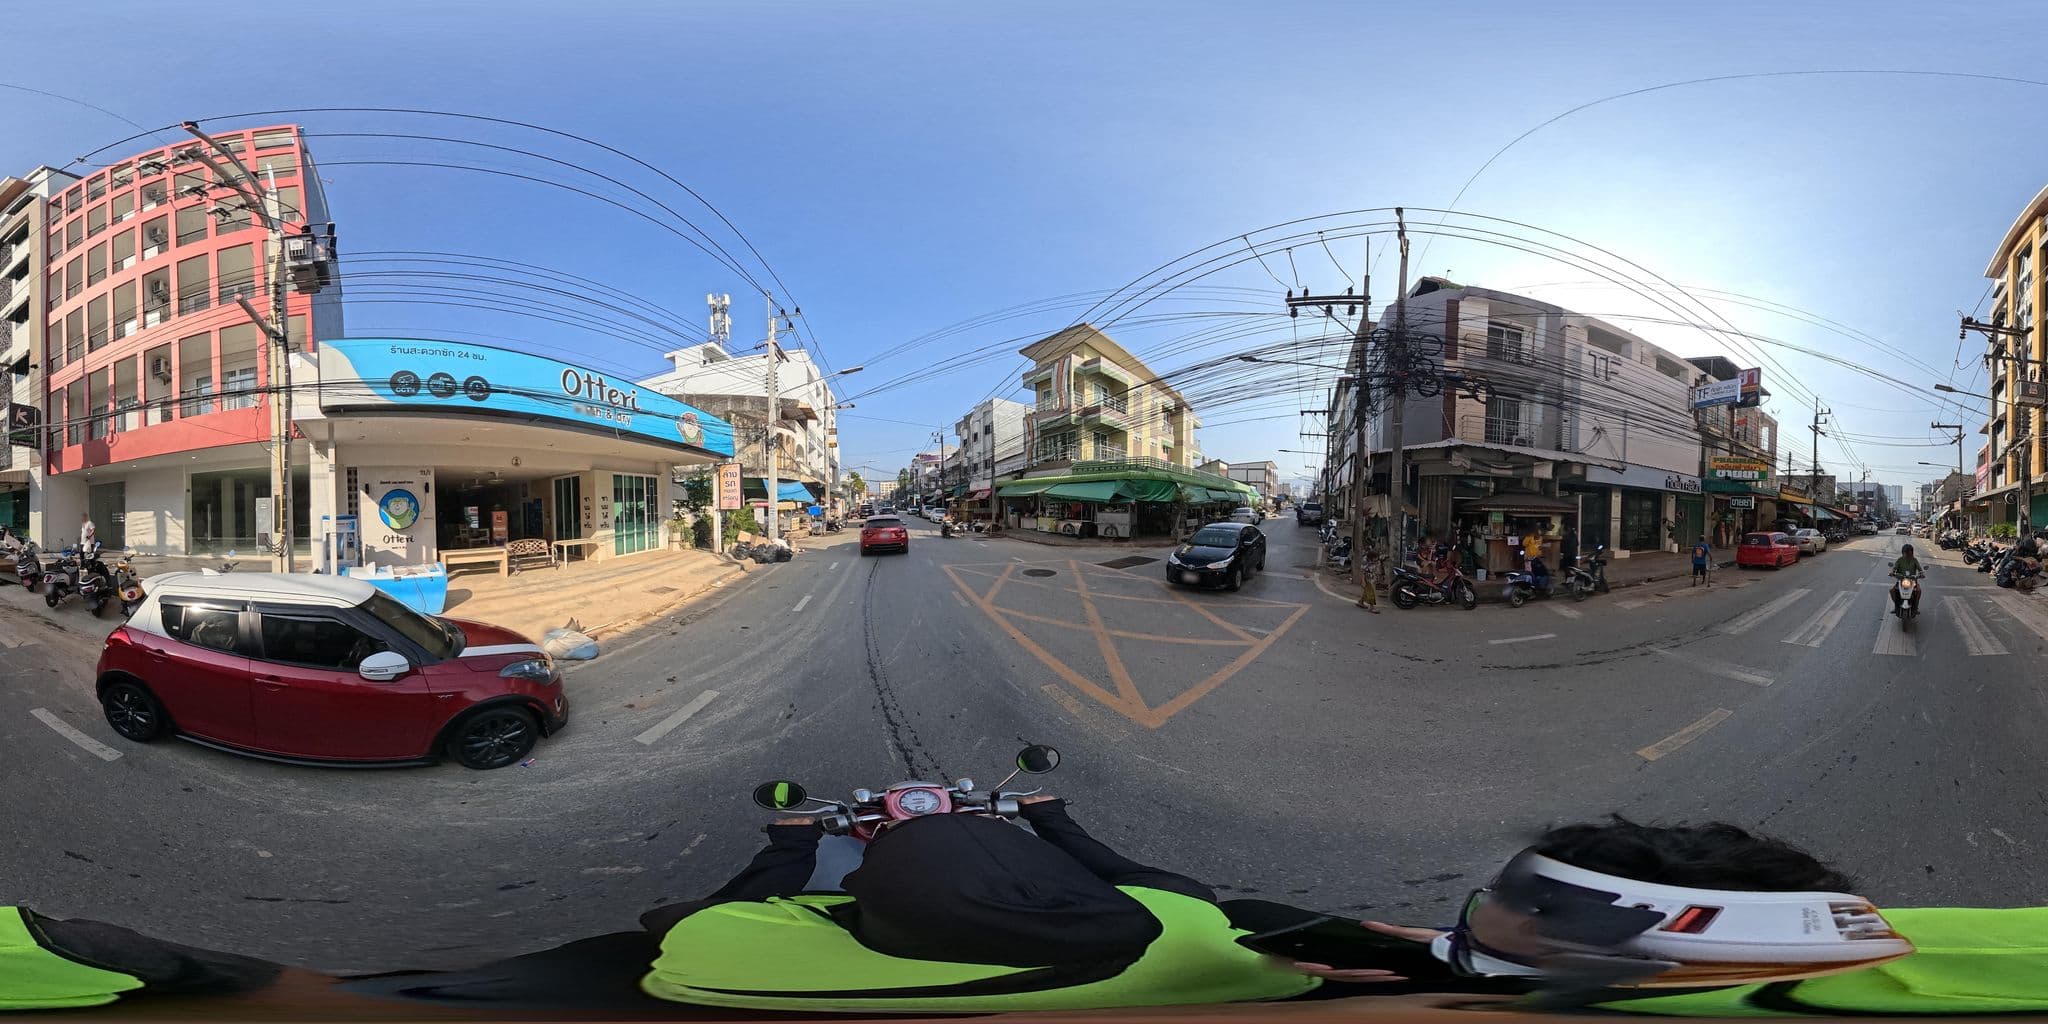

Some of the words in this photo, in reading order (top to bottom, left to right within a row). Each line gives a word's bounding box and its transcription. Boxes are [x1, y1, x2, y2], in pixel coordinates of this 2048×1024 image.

[390, 345, 455, 357] ร้านสะดวกซัก
[457, 350, 469, 358] 24
[472, 353, 487, 361] ชม.
[561, 368, 641, 412] Otteri
[616, 411, 631, 426] dry
[383, 534, 415, 544] Otteri
